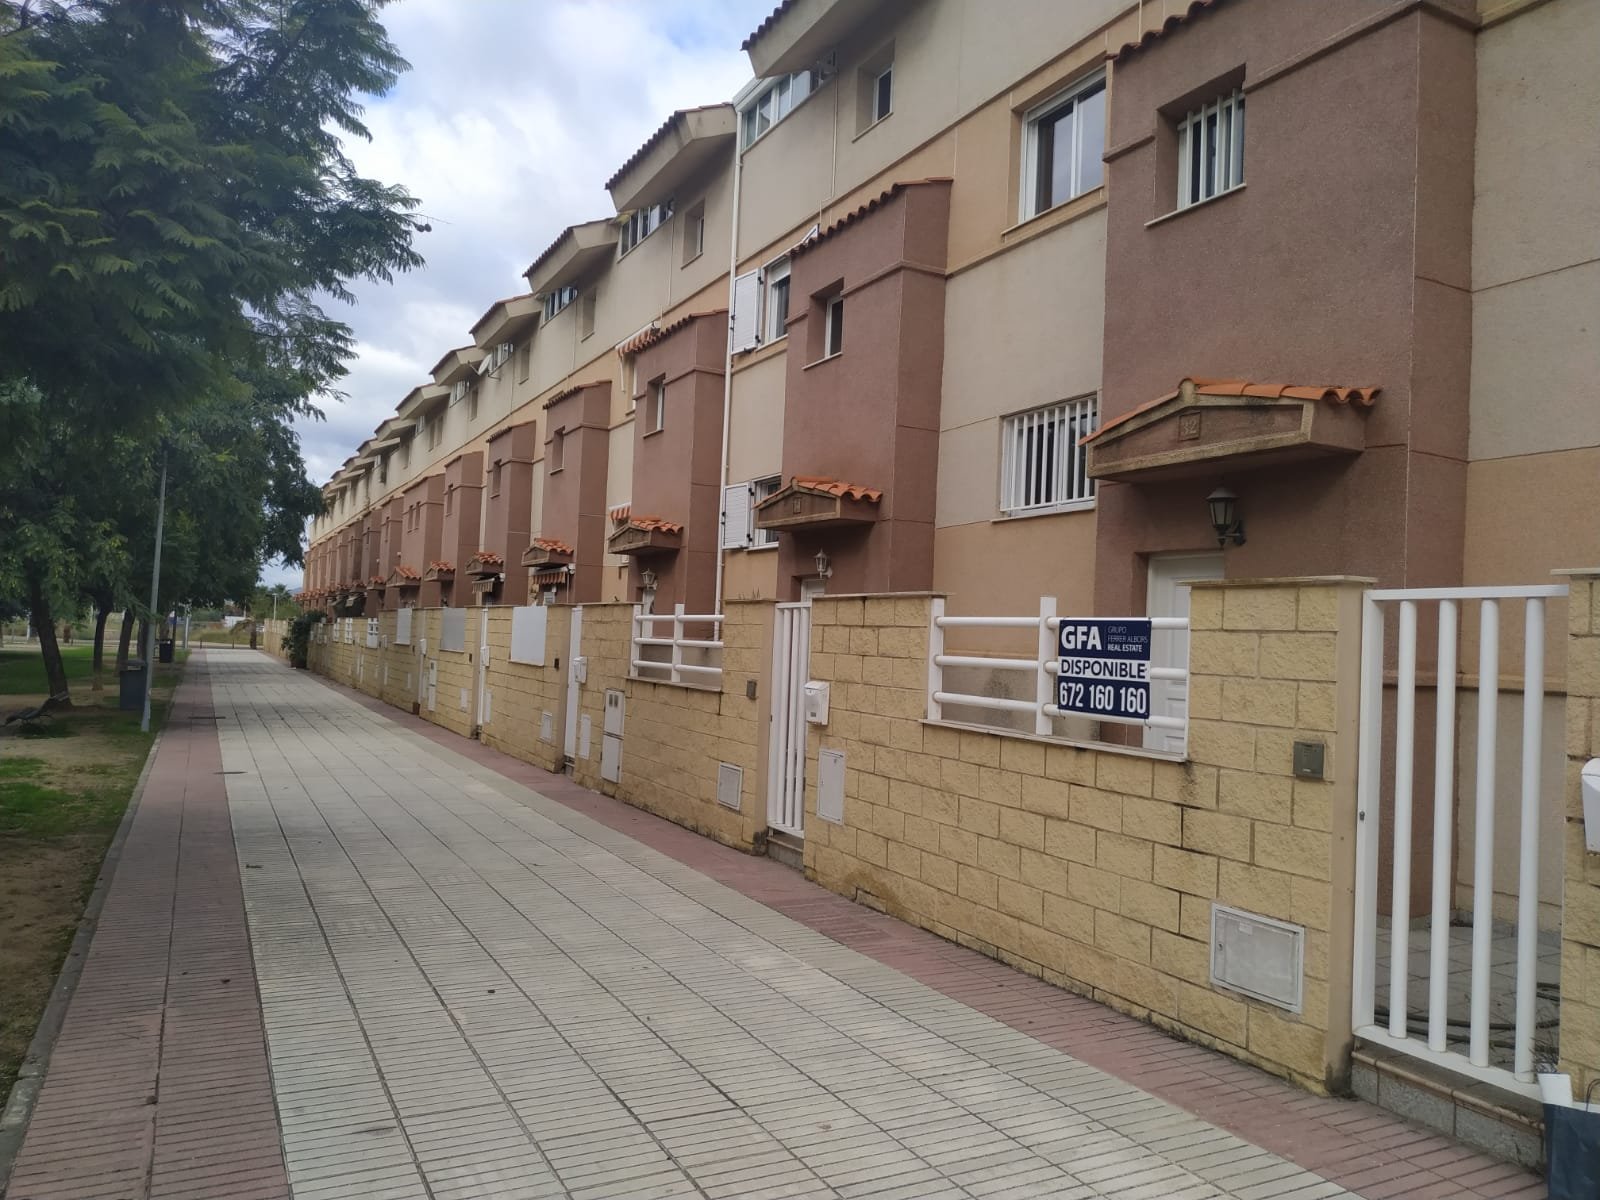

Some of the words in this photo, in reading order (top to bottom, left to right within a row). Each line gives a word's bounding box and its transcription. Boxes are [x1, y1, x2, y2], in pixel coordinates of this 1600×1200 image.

[1061, 625, 1102, 650] GFA
[1107, 625, 1127, 634] GRUPO
[1107, 644, 1121, 652] REAL
[1122, 644, 1143, 653] ESTATE
[1061, 659, 1146, 679] DISPONIBLE
[1060, 682, 1084, 707] 672
[1089, 684, 1114, 710] 160
[1119, 686, 1147, 714] 160
